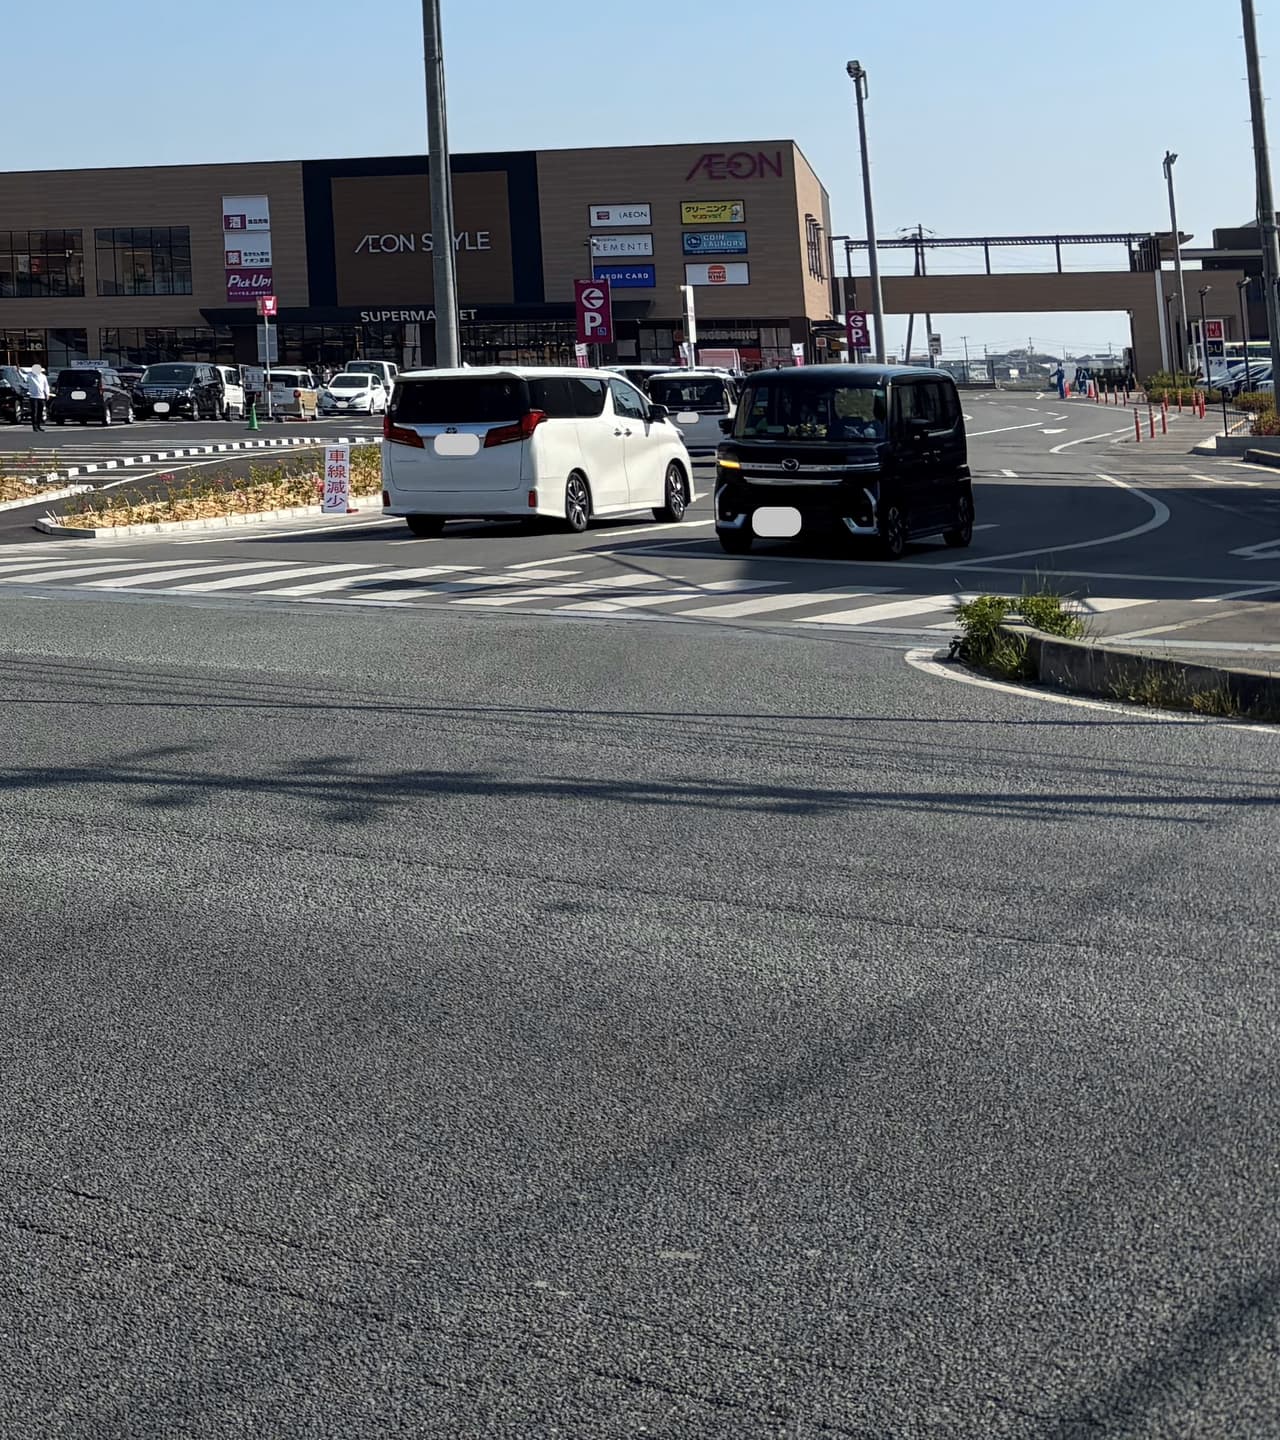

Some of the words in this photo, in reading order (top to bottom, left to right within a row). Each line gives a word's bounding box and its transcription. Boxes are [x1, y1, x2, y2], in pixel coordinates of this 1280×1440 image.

[421, 231, 491, 252] SYLE
[625, 272, 649, 280] CARD
[360, 309, 478, 323] SUPERMAET
[583, 311, 603, 337] P
[851, 328, 863, 343] P
[326, 449, 347, 509] 車線減少
